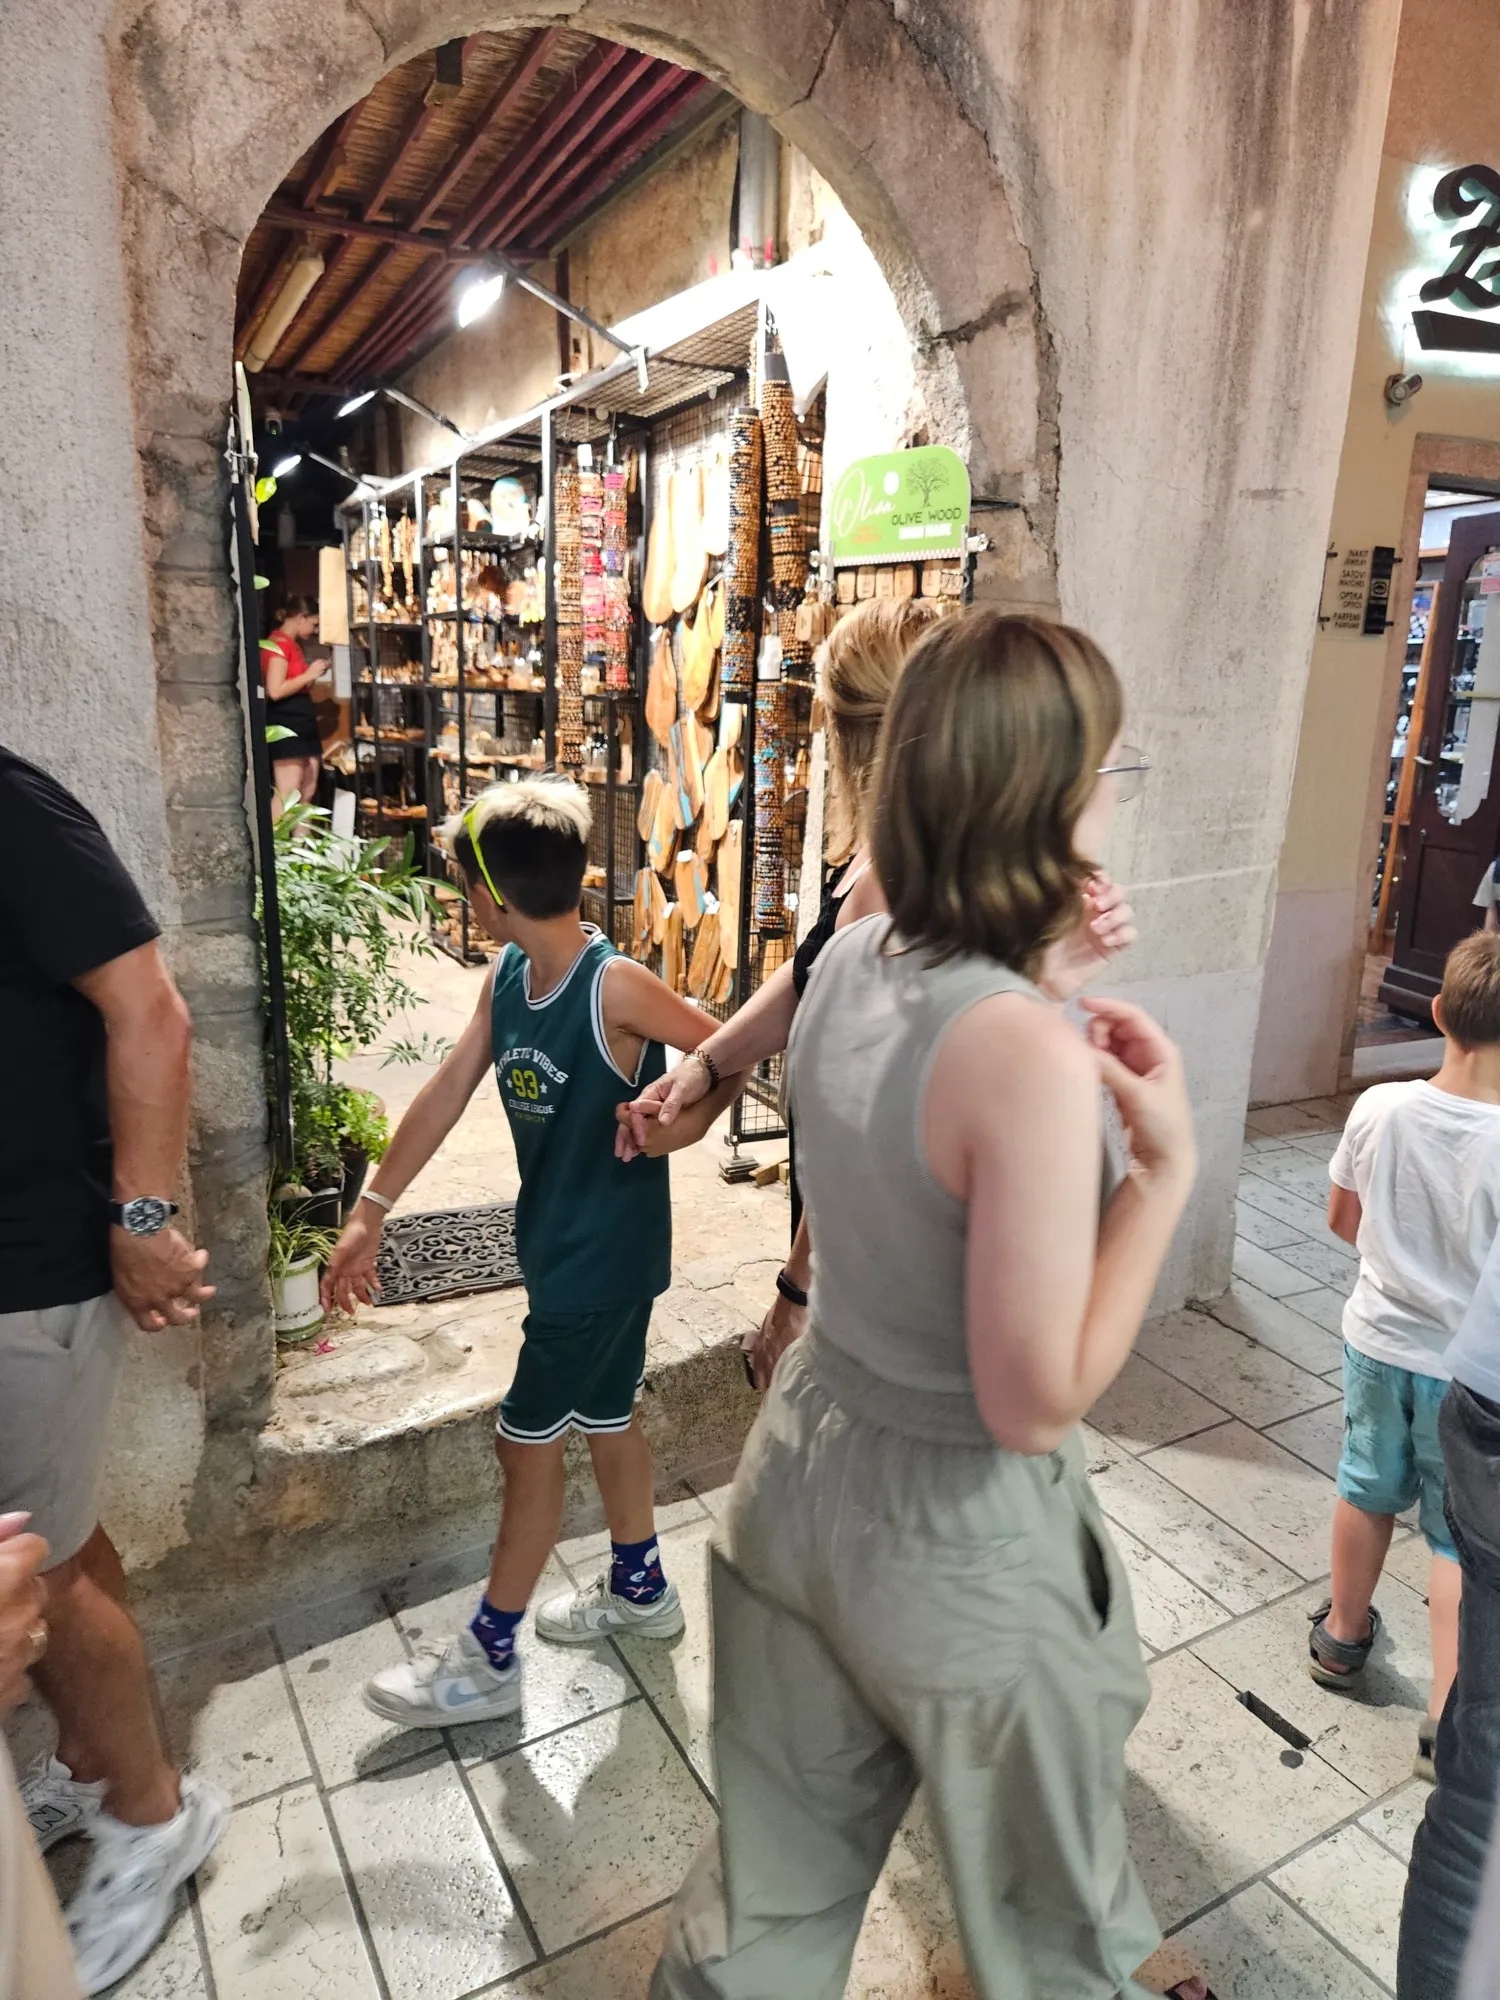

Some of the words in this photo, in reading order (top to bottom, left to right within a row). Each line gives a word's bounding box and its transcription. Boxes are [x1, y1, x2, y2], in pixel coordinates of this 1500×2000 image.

[891, 511, 923, 526] OLIVE
[927, 507, 962, 522] WOOD
[532, 1048, 569, 1084] VIBES
[511, 1068, 539, 1100] 93
